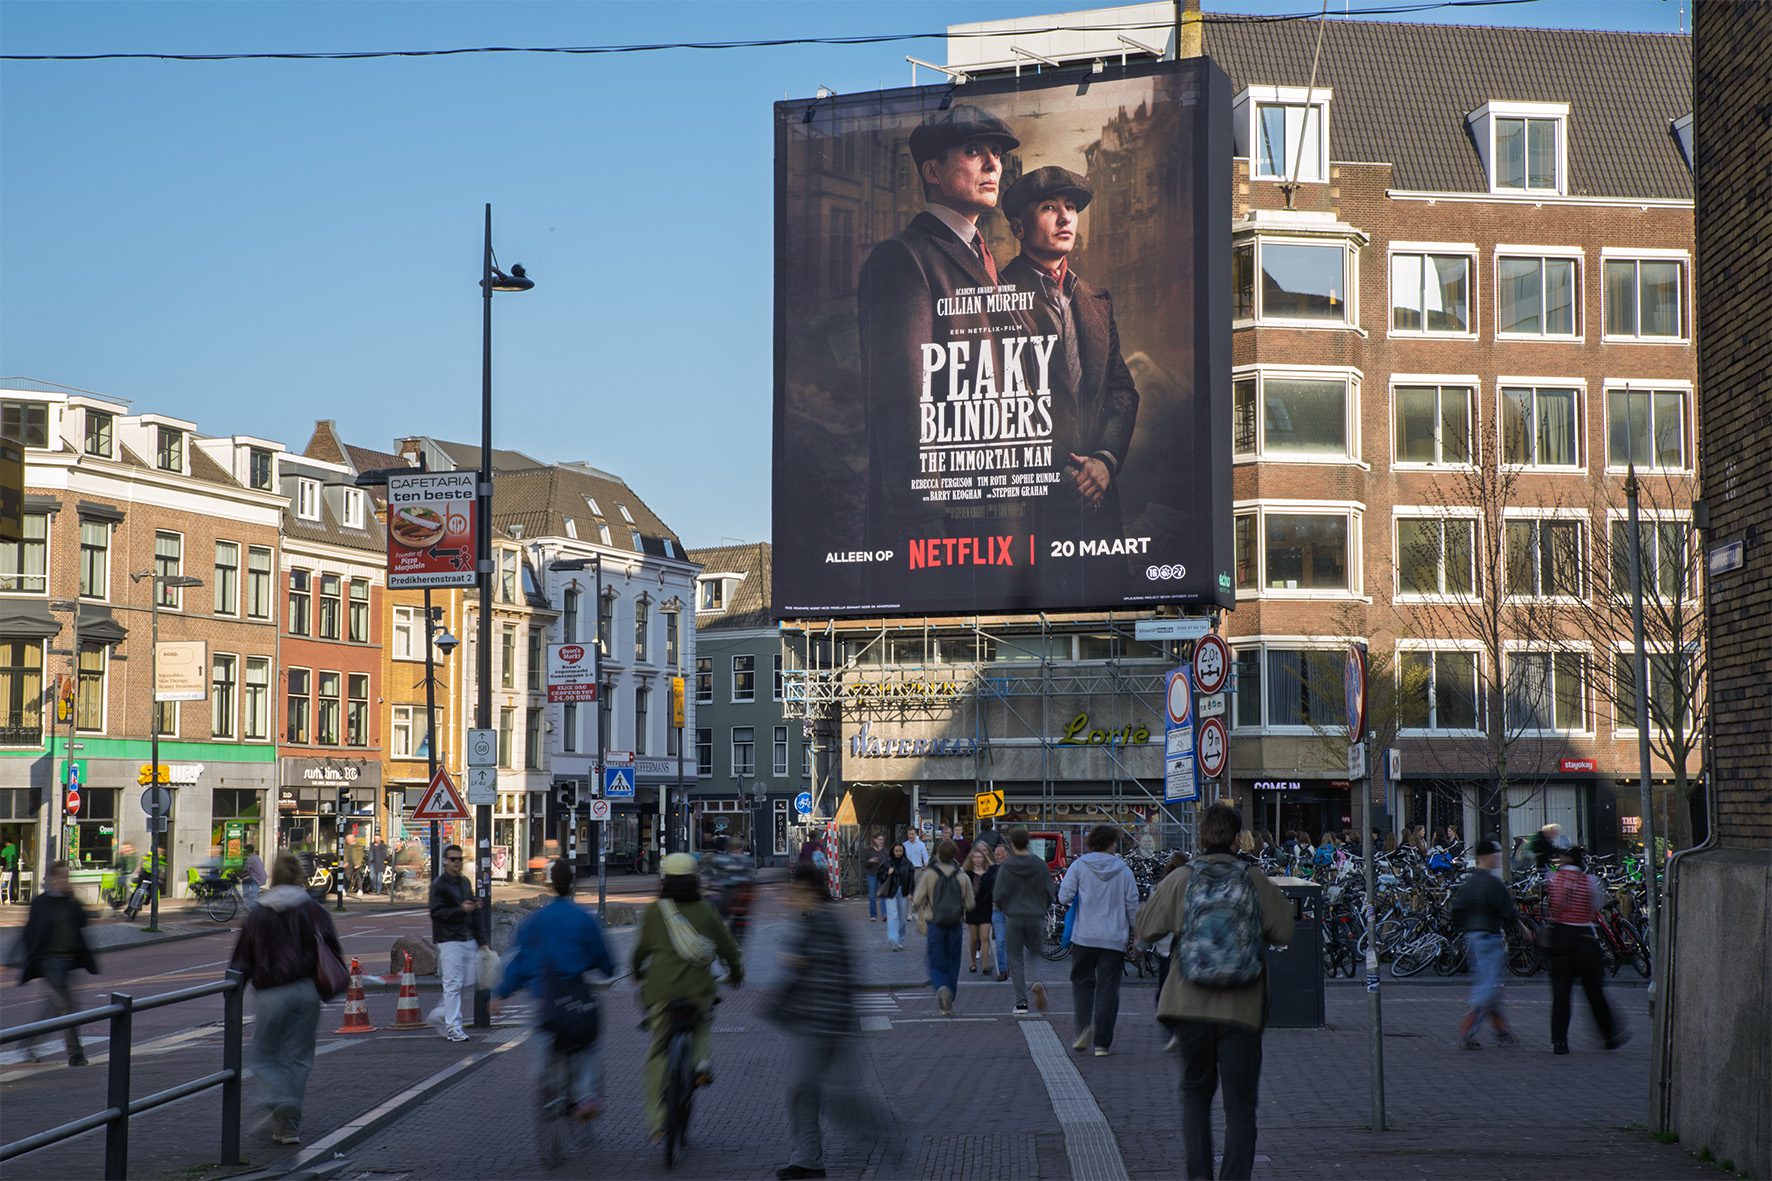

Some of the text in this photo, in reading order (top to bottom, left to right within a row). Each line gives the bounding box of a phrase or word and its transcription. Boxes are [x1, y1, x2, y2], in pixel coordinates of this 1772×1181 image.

[956, 287, 976, 295] ACADEMY
[937, 292, 1035, 316] CILLIAN MURPHY
[968, 325, 1022, 334] NETFLIX-FILM
[920, 334, 1058, 402] PEAKY
[920, 396, 1052, 443] BLINDERS
[920, 446, 1052, 472] THE IMMORTAL MAN
[391, 476, 472, 489] CAFETARIA
[911, 472, 1060, 490] REBECCA FERGUSON TIM ROTH SOPHIE RUNDLE
[394, 490, 472, 501] ten beste
[930, 490, 951, 501] BARRY
[953, 489, 982, 500] KEOGHAN
[992, 487, 1020, 498] STEPHEN
[1021, 485, 1048, 497] GRAHAM
[825, 536, 1151, 570] ALLEEN OP NETFLIX 20 MAART
[391, 576, 465, 584] Predikherenstraat
[851, 720, 979, 758] WATERMAN
[1565, 761, 1592, 770] stayokay
[99, 825, 114, 834] Open
